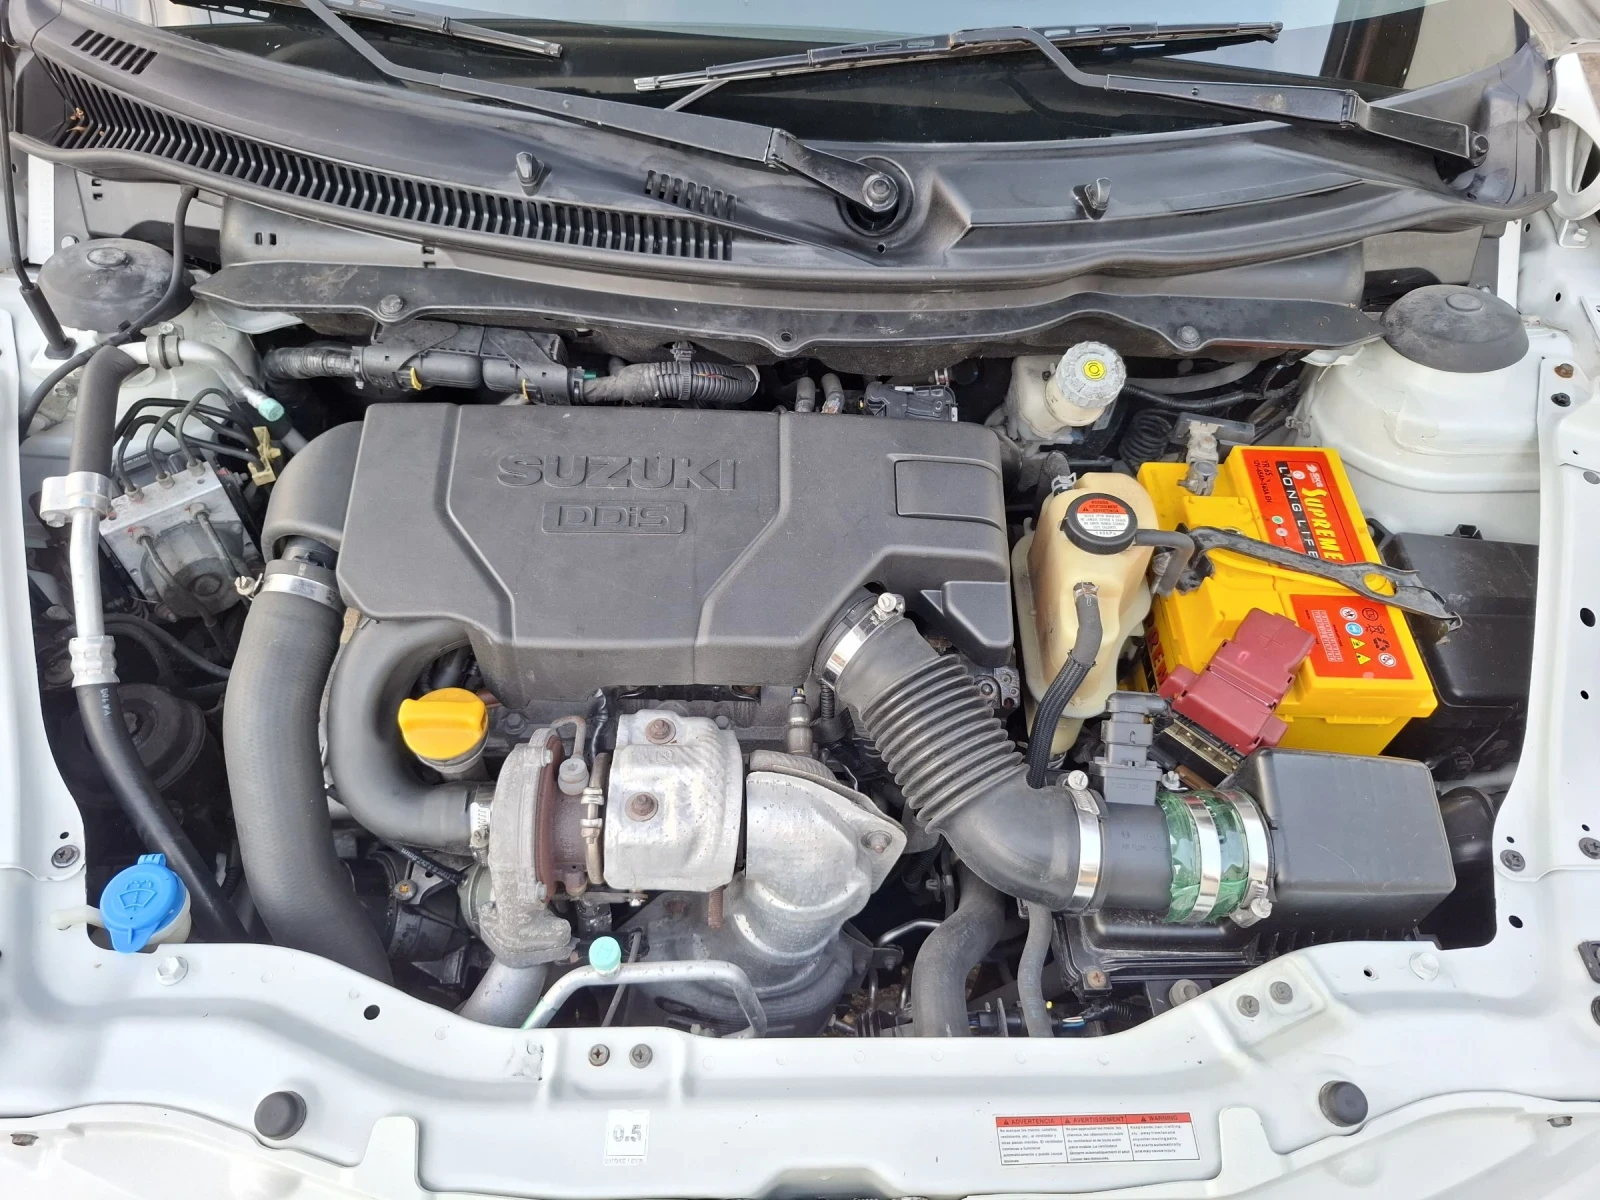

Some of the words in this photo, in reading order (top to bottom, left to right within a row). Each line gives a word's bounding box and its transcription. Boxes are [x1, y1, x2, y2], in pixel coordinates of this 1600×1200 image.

[497, 454, 737, 491] SUZUKI
[557, 504, 670, 528] DDiS
[1278, 466, 1302, 512] LONG
[1297, 520, 1319, 558] LIFE
[1301, 487, 1345, 561] SUPREME
[613, 1124, 642, 1142] 0.5
